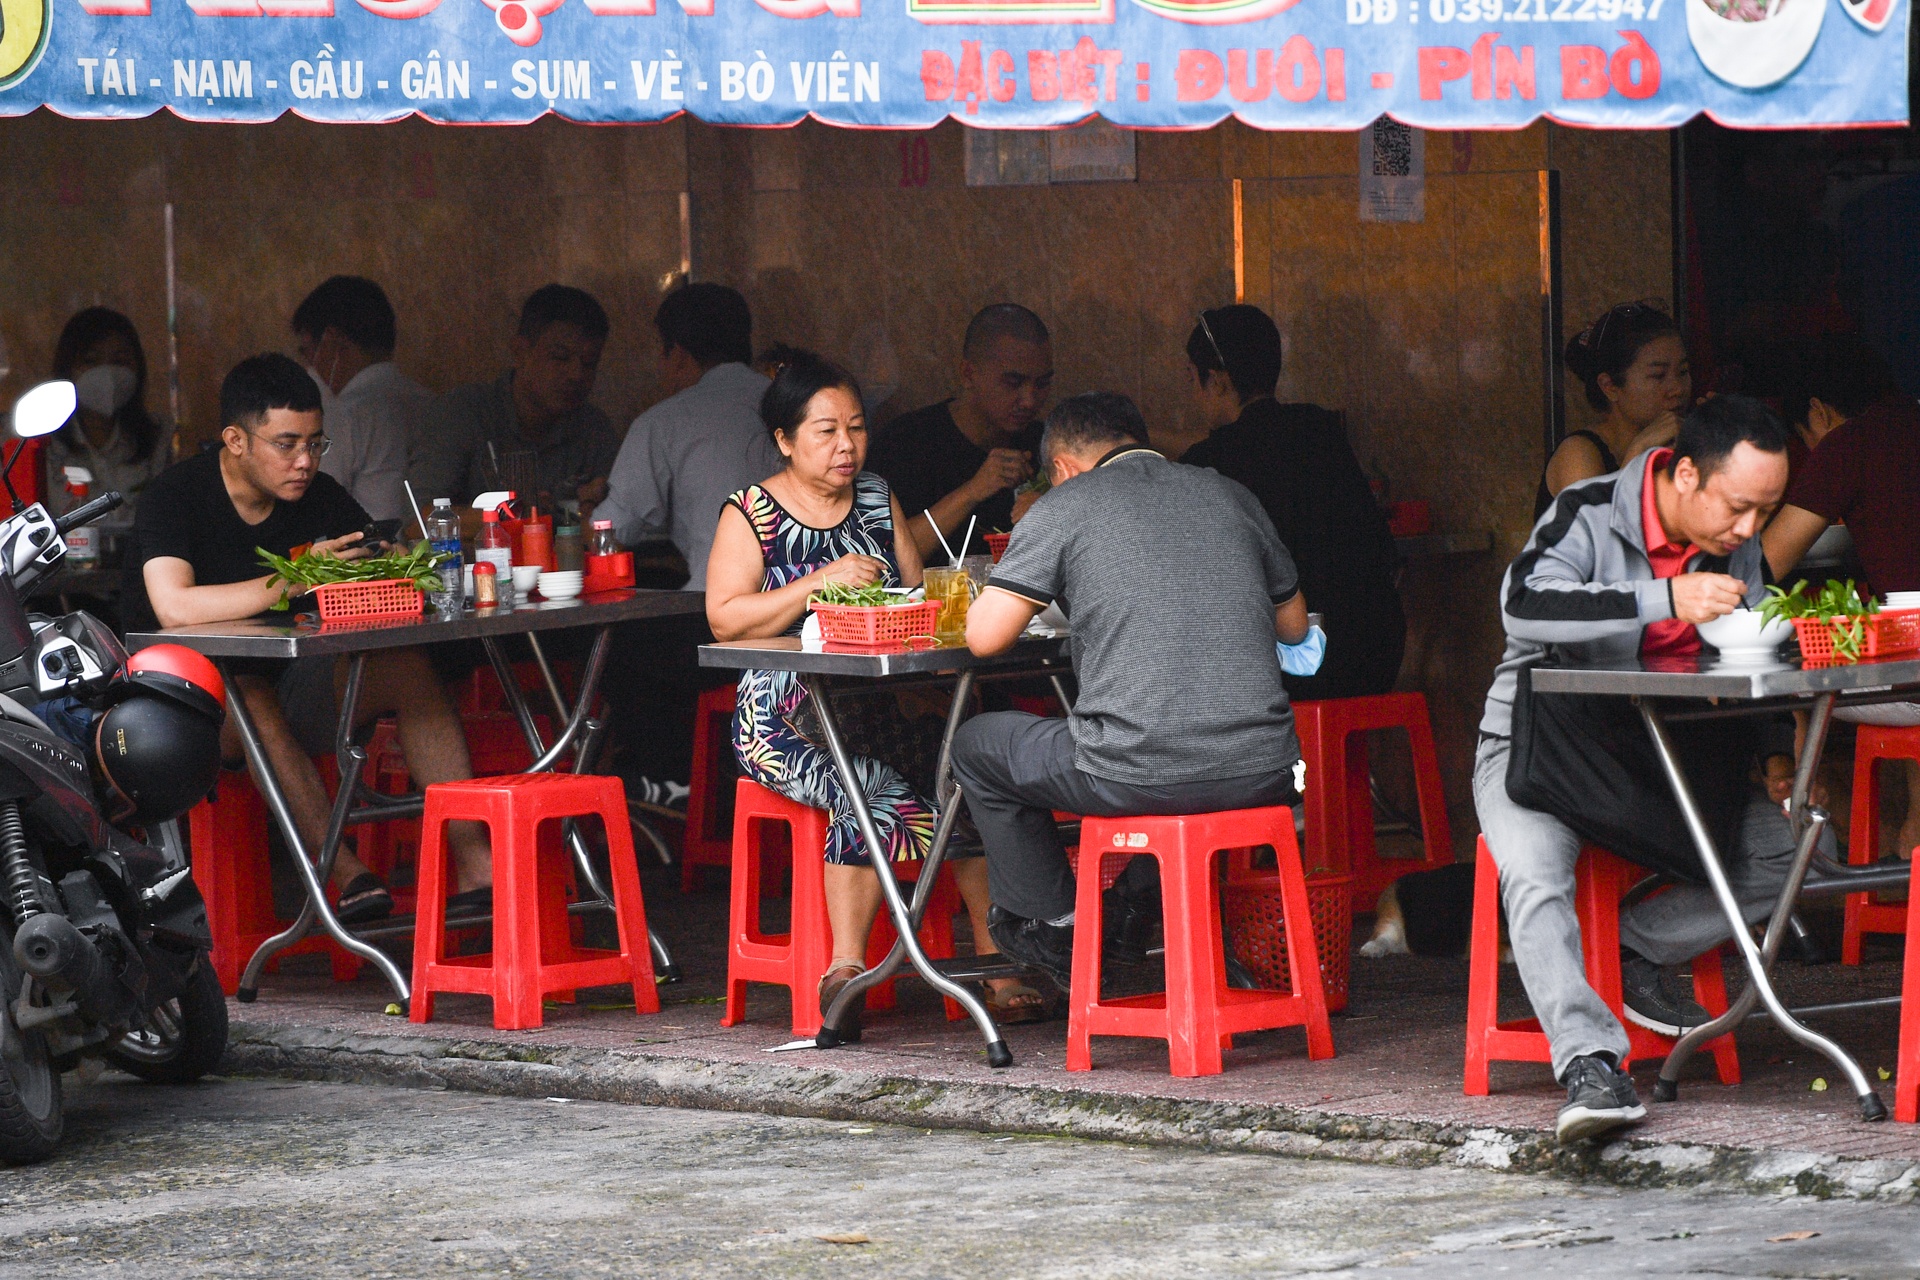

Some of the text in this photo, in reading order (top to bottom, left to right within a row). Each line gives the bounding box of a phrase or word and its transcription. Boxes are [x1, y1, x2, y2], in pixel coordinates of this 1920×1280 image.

[1346, 0, 1398, 25] DĐ
[1429, 0, 1665, 24] 039.2122947
[77, 47, 138, 95] TÁI
[173, 59, 254, 106] NẠM
[289, 43, 365, 99] GẦU
[401, 49, 470, 99] GÂN
[510, 59, 591, 108] SỤM
[630, 49, 685, 101] VÈ
[720, 49, 776, 103] BÒ
[790, 50, 881, 103] VIÊN
[919, 40, 1017, 115] ĐẶC
[1027, 35, 1123, 111] BIỆT
[1174, 34, 1347, 103] ĐUÔI
[1417, 31, 1538, 101] PÍN
[1560, 29, 1662, 101] BÒ
[899, 135, 930, 188] 10
